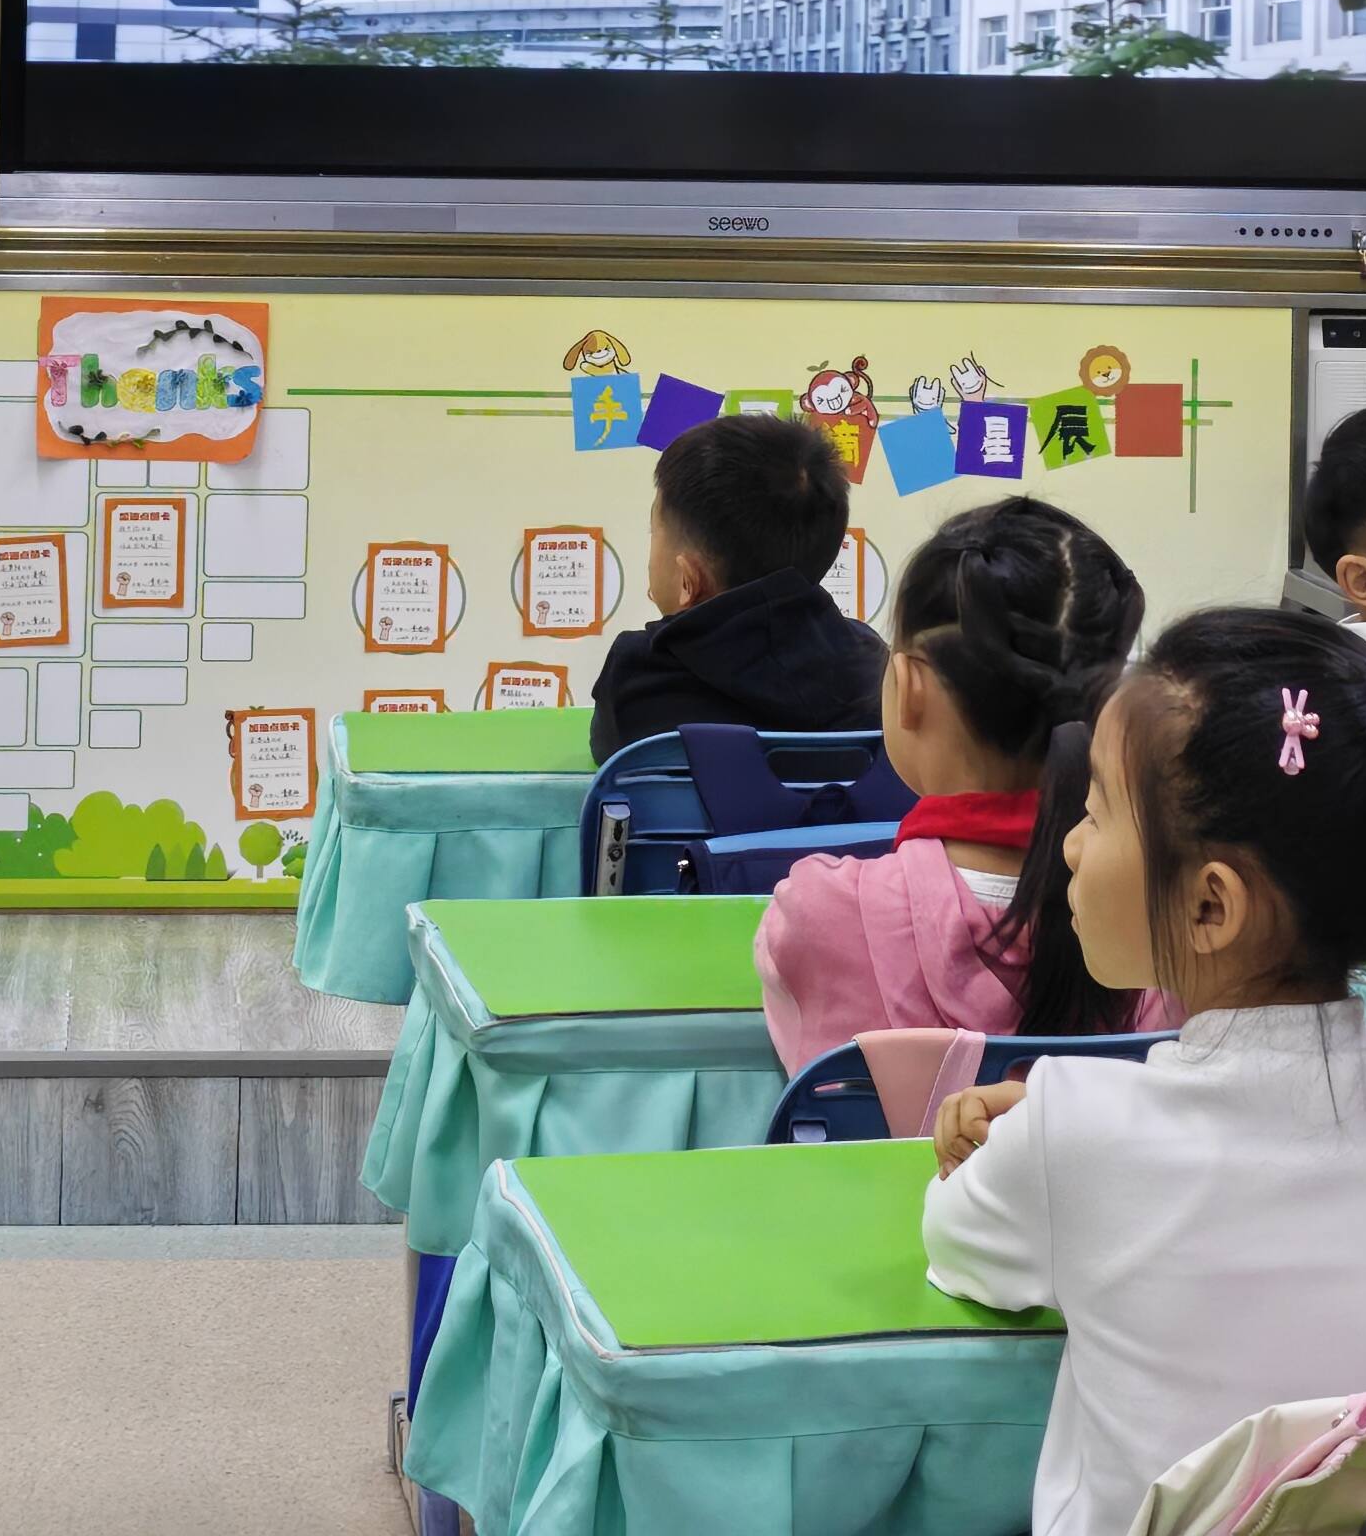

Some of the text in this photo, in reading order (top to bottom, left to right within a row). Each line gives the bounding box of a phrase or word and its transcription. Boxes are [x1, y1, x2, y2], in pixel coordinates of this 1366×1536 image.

[708, 216, 770, 231] seewo
[589, 385, 629, 448] 手
[980, 415, 1014, 464] 星
[1038, 404, 1097, 460] 辰
